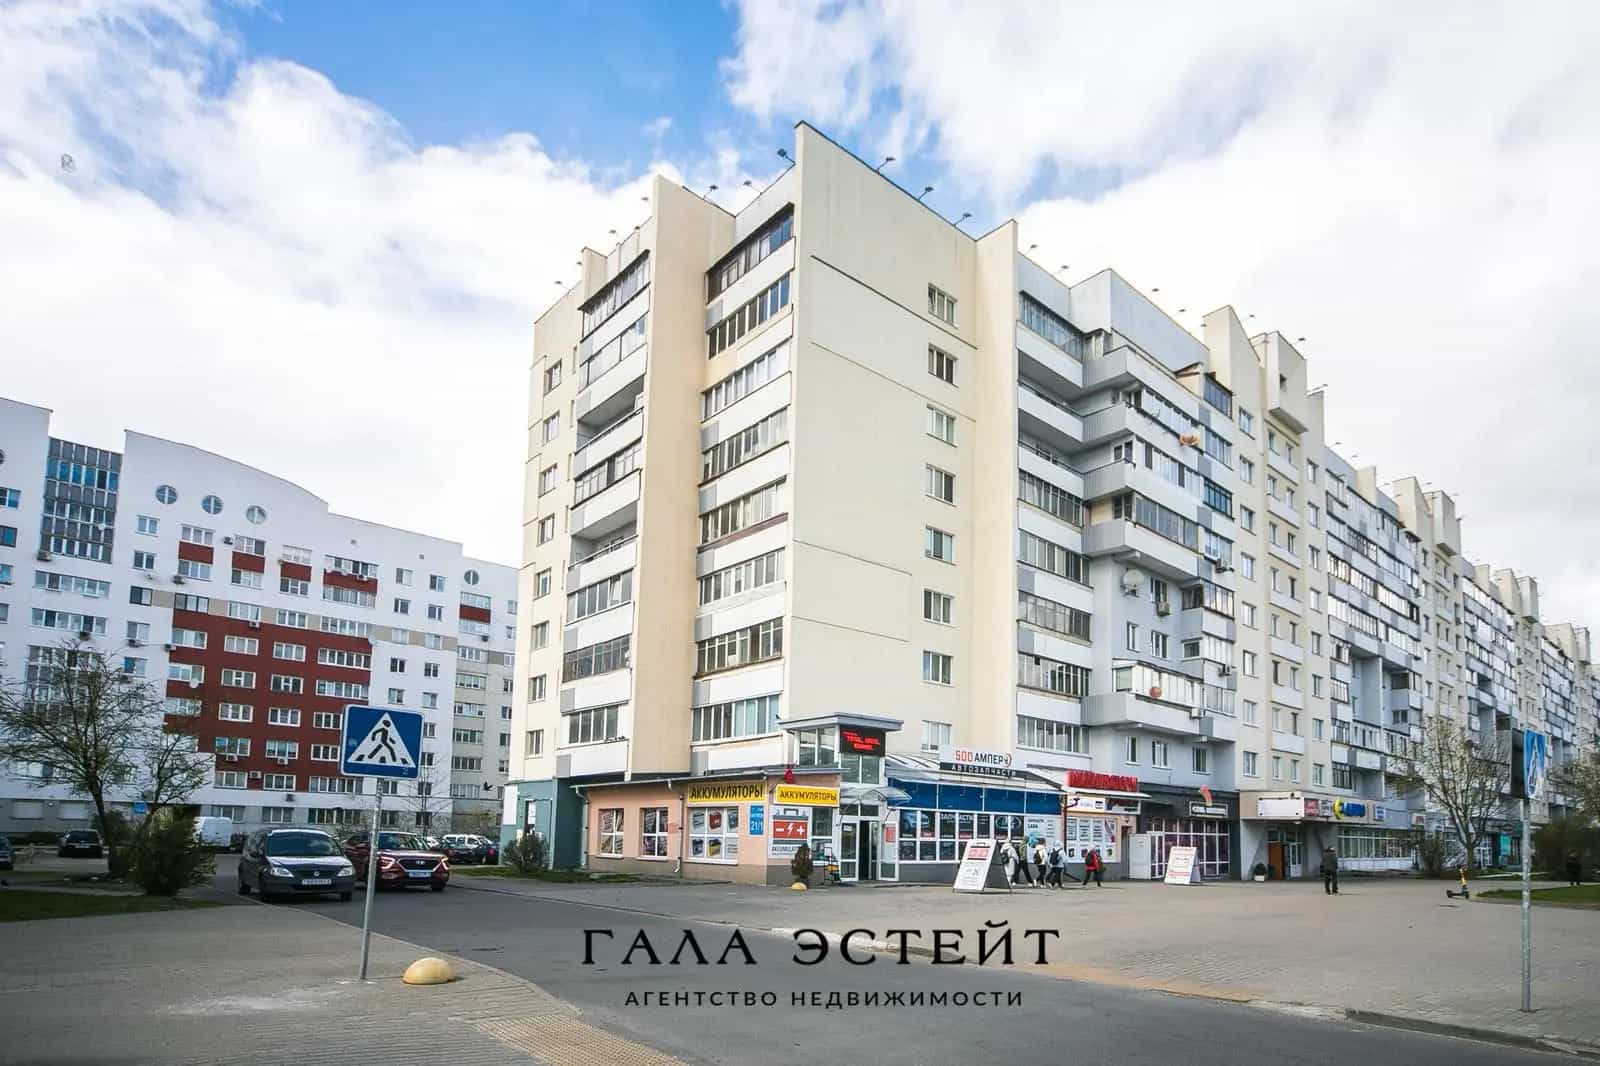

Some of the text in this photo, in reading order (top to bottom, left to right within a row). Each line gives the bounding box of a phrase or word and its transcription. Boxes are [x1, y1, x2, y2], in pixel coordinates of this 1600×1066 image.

[955, 750, 1003, 765] 500 АМПЕР
[951, 764, 1017, 776] АВТОЗАПЧАСТИ
[690, 783, 763, 799] АККУМУЛЯТОРЫ
[779, 790, 837, 801] АККУМУЛЯТОРЫ
